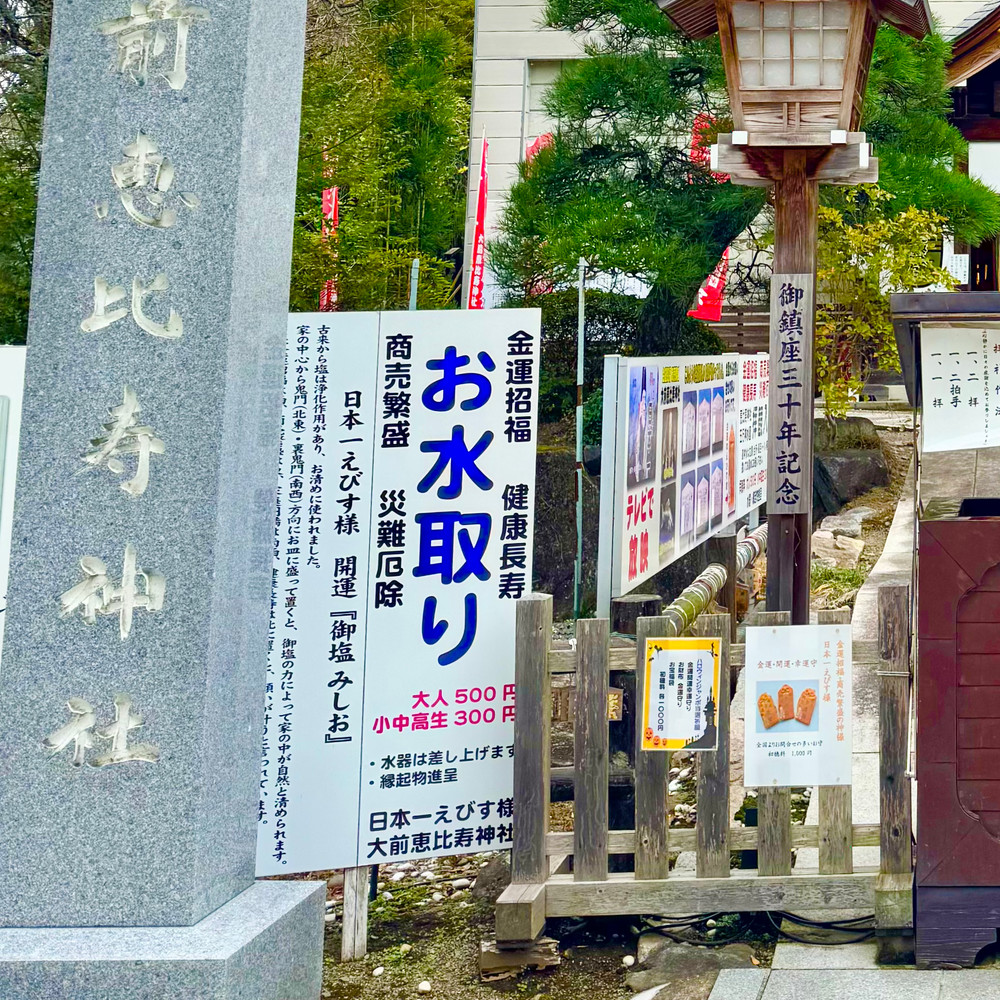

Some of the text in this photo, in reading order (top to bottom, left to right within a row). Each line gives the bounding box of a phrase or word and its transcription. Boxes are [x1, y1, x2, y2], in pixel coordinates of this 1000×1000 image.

[775, 282, 804, 505] 御鎮座三十年記念
[375, 333, 413, 609] 商売繁盛 災難厄除
[498, 330, 534, 599] 金運招福 健康長寿
[412, 345, 496, 667] お水取り
[627, 487, 654, 530] テレビで
[628, 529, 648, 582] 放映
[411, 689, 449, 709] 大人
[454, 686, 496, 704] 500
[823, 641, 831, 702] 日本一えびす様
[372, 711, 448, 734] 小中高生
[454, 708, 495, 726] 300
